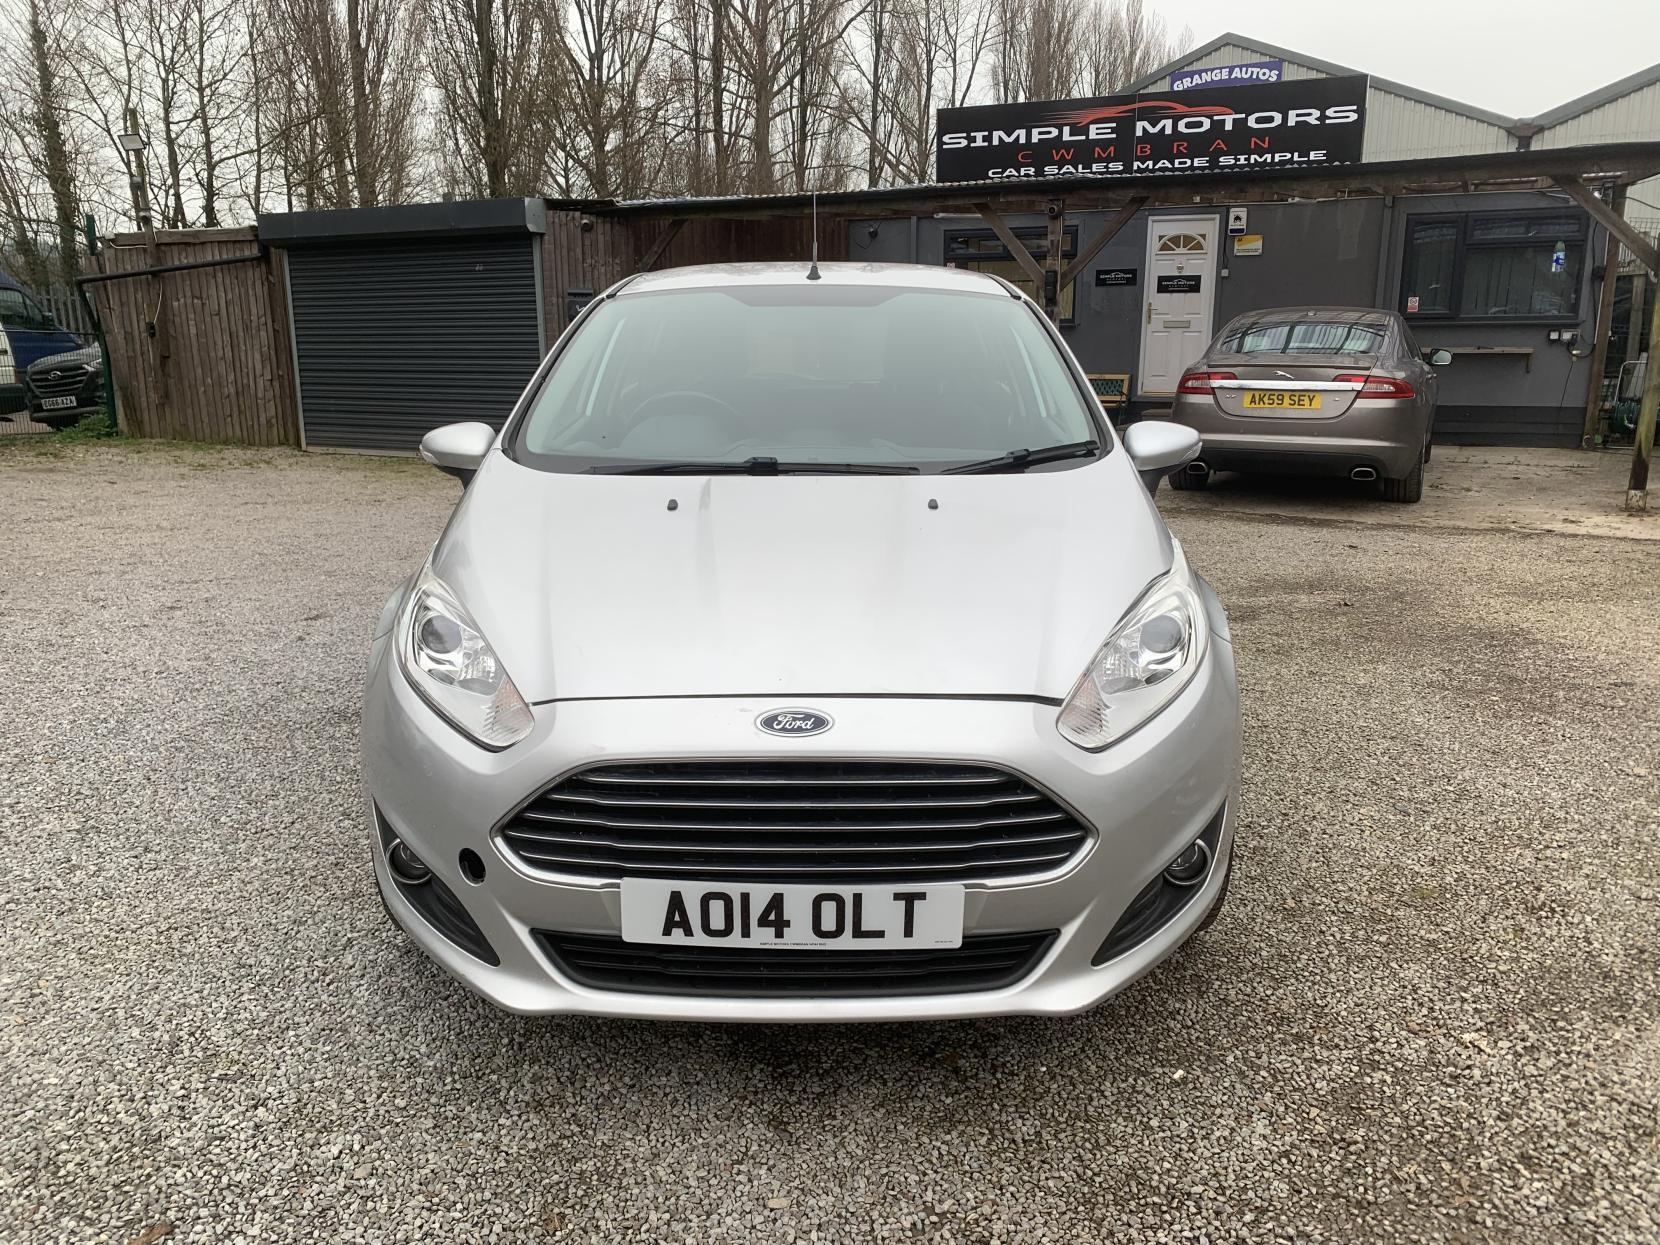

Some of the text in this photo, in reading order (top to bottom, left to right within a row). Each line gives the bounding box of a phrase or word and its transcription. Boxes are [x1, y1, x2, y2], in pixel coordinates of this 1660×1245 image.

[1173, 67, 1280, 91] GRANGE AUTOS
[942, 105, 1359, 149] SIMPLE MOTORS
[988, 150, 1327, 178] CAR SALES MADE SIMPLE
[1249, 392, 1285, 406] AK59
[1288, 394, 1316, 407] SEY
[773, 713, 815, 730] Ford
[661, 890, 927, 940] AO14 OLT
